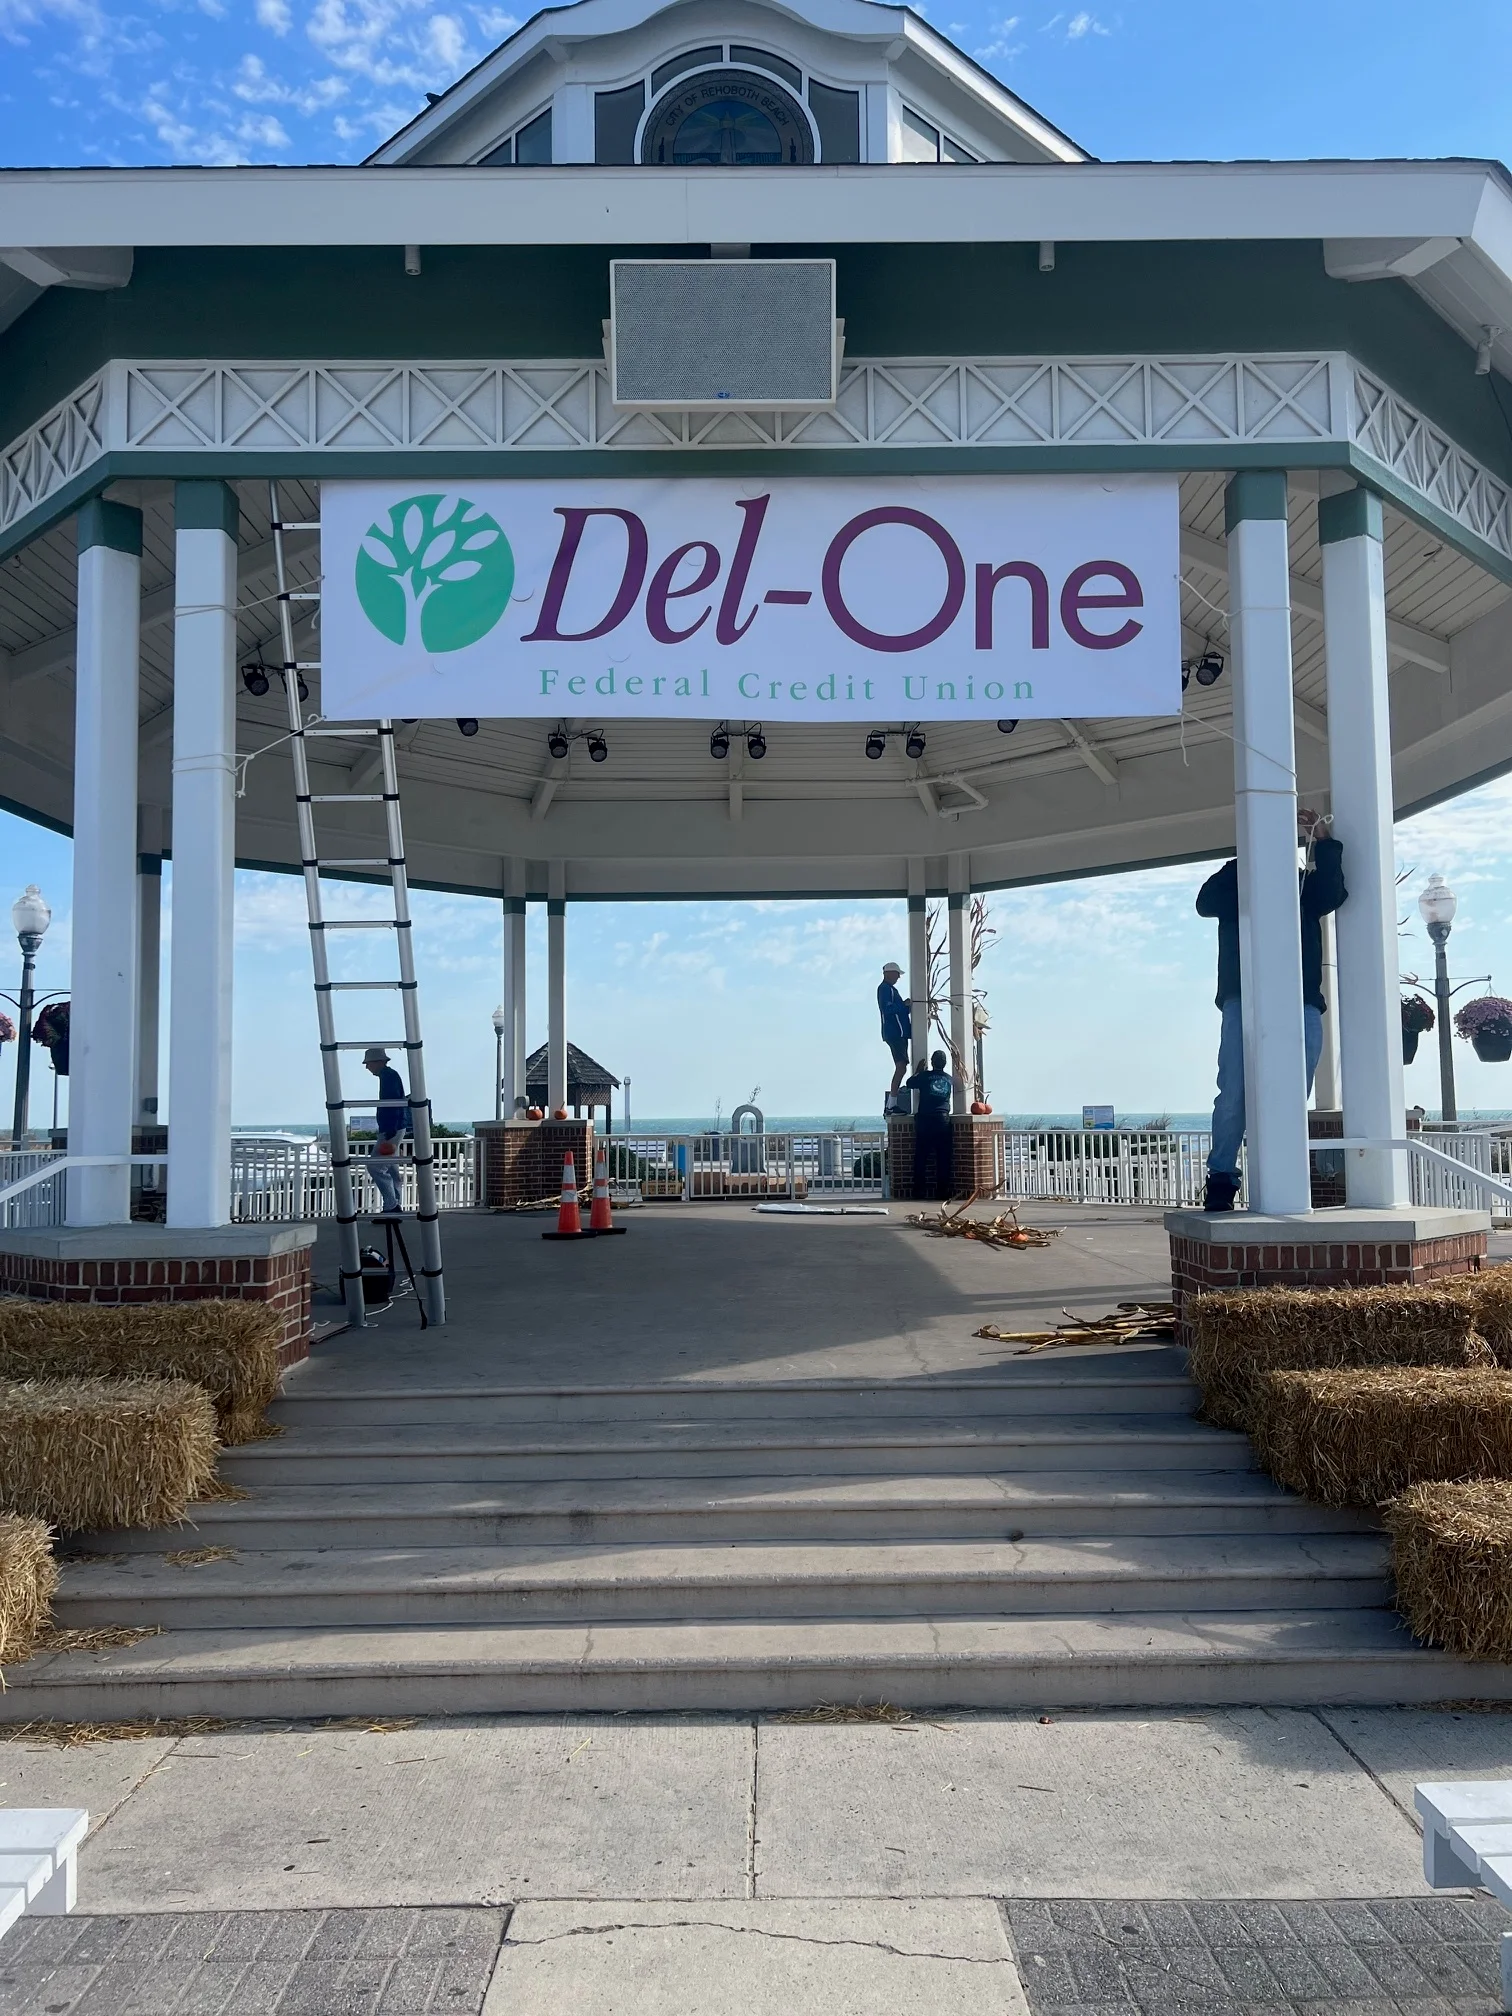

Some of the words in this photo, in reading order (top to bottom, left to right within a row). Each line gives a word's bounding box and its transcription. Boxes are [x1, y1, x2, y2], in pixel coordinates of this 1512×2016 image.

[665, 104, 682, 127] CITY
[684, 93, 699, 108] OF
[701, 85, 760, 101] REHOBOTH
[760, 97, 790, 126] BEACH
[520, 492, 1144, 653] Del-One
[538, 665, 711, 700] Federal
[736, 672, 876, 703] Credit
[902, 673, 1036, 705] Union
